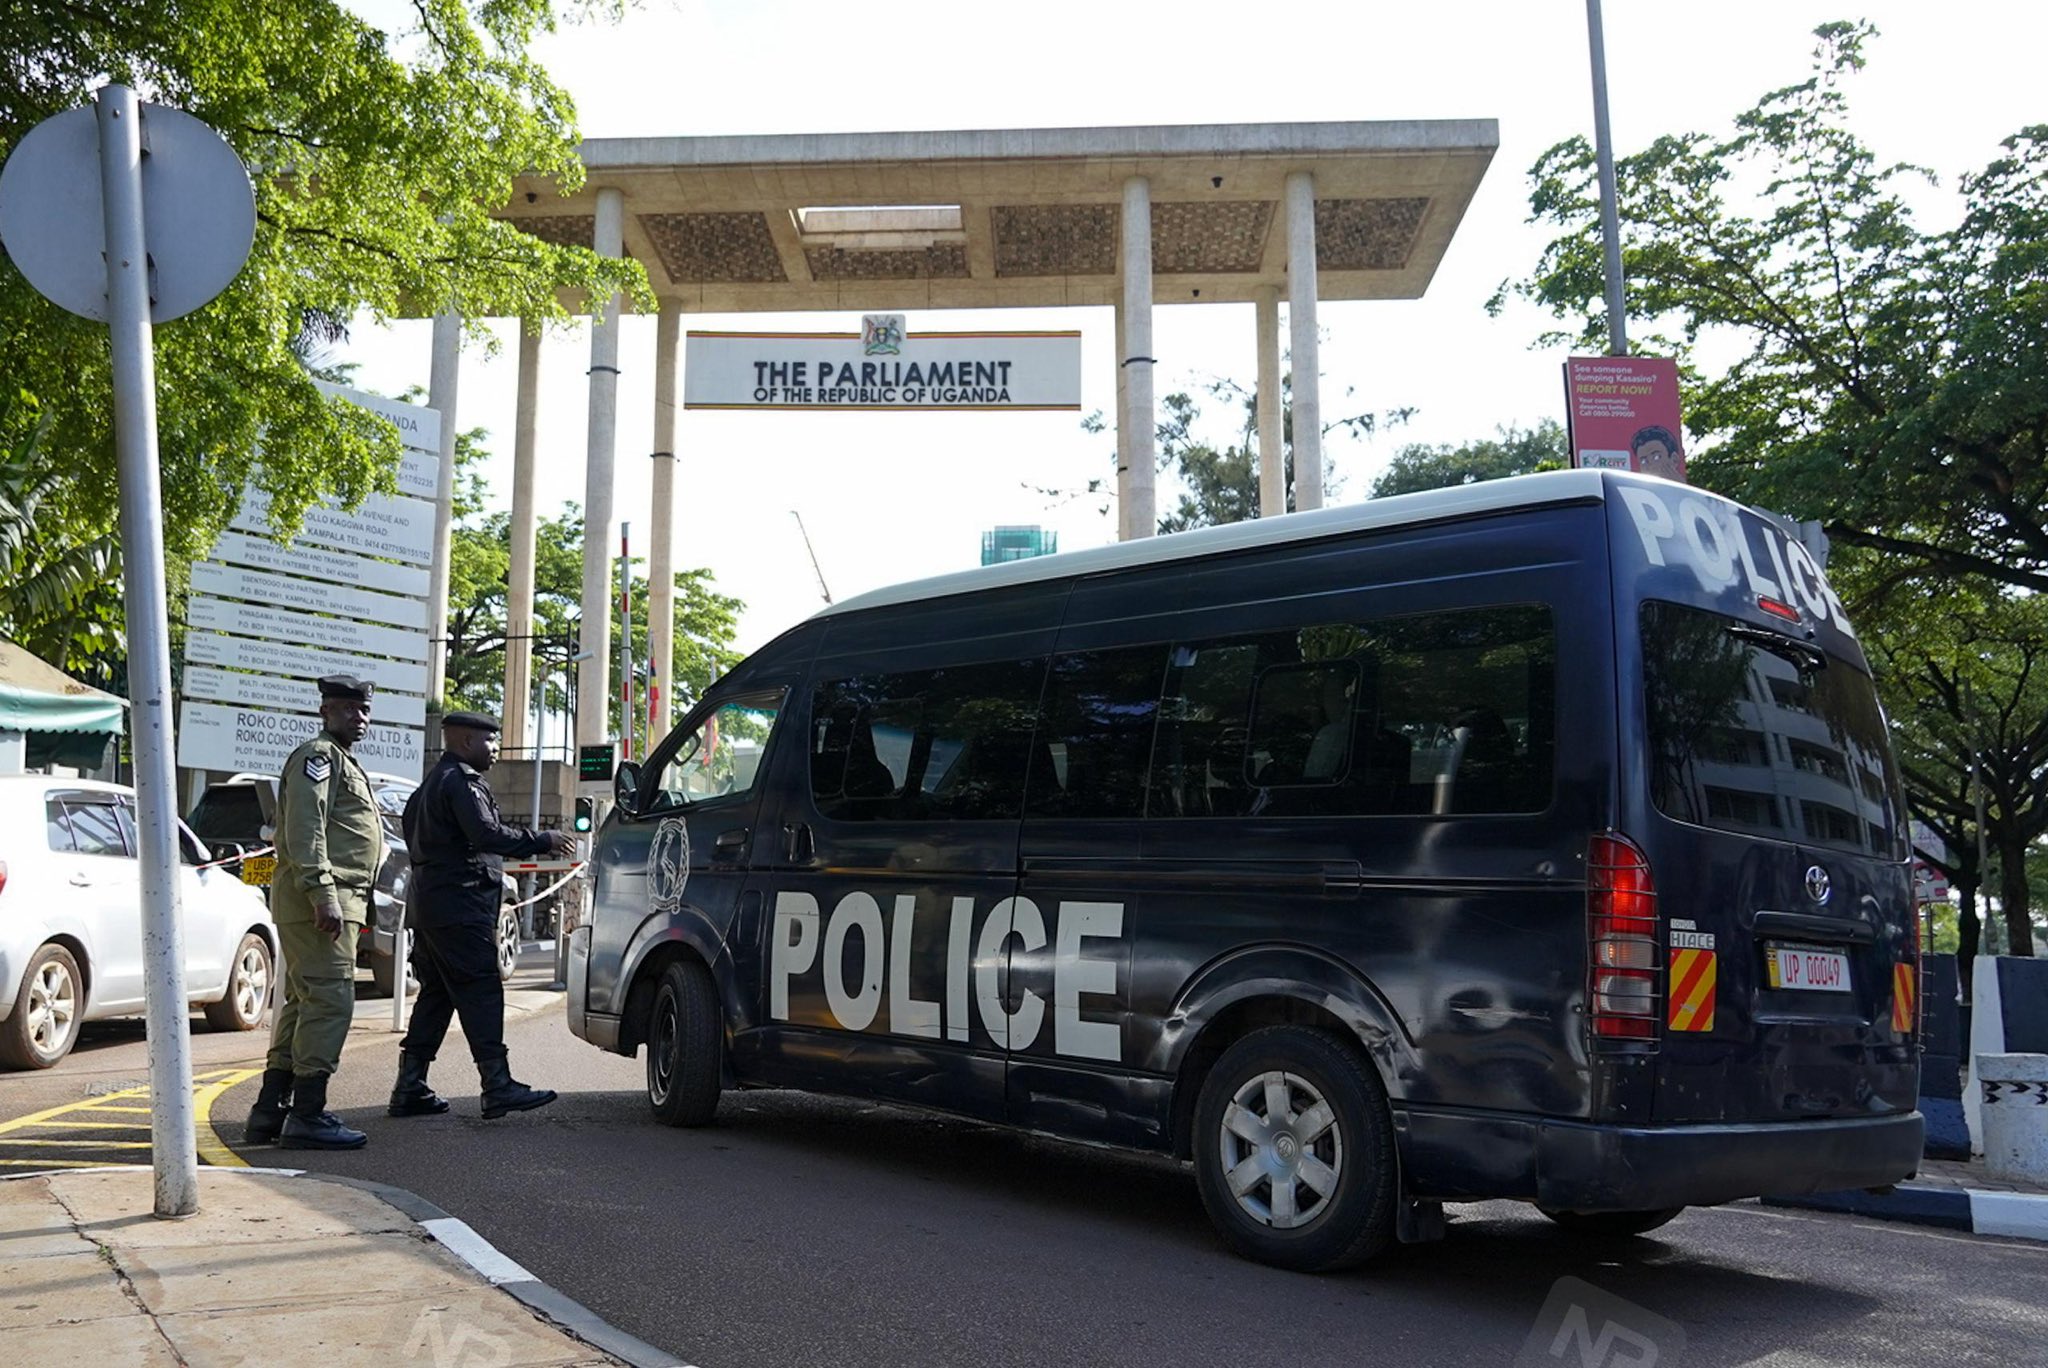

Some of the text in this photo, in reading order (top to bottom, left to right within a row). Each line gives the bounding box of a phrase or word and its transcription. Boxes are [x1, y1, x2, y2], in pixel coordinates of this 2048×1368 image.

[754, 361, 1012, 386] THE PARLIAMENT
[1574, 364, 1633, 374] See someone
[1575, 373, 1614, 384] dumping
[754, 388, 1011, 403] OF THE REPUBLIC OF UGANDA
[1576, 384, 1653, 395] REPORT NOW!
[362, 509, 410, 527] AVENUE AND
[308, 527, 345, 542] KAMPALA
[366, 524, 388, 537] ROAD
[245, 541, 274, 553] MINISTRY
[286, 549, 309, 560] WORKS
[309, 553, 323, 562] AND
[324, 557, 359, 569] TRANSPORT
[258, 555, 271, 564] BOX
[1617, 486, 1856, 638] POLICE
[254, 588, 267, 597] BOX
[285, 594, 315, 606] KAMPALA
[282, 582, 296, 591] AND
[297, 585, 328, 597] PARTNERS
[251, 622, 265, 631] BOX
[286, 628, 316, 639] KAMPALA
[312, 620, 325, 629] AND
[326, 623, 357, 634] PARTNERS
[239, 643, 377, 670] ASSOCIATED CONSULTING ENGINEERS LIMITED
[251, 657, 265, 665] BOX
[283, 661, 313, 672] KAMPALA
[239, 678, 258, 688] MULTI
[262, 682, 295, 693] KONSULTS
[251, 691, 265, 700] BOX
[282, 696, 312, 706] KAMPALA
[237, 712, 276, 730] ROKO
[380, 730, 401, 744] LTD
[403, 733, 412, 746] &
[235, 729, 265, 744] ROKO
[386, 746, 402, 759] LTD
[403, 749, 419, 763] (JV)
[235, 746, 253, 756] PLOT
[248, 761, 263, 770] BOX
[253, 859, 274, 871] UBP
[1671, 932, 1714, 949] HIACE
[771, 891, 1125, 1062] POLICE
[1784, 954, 1800, 984] UP
